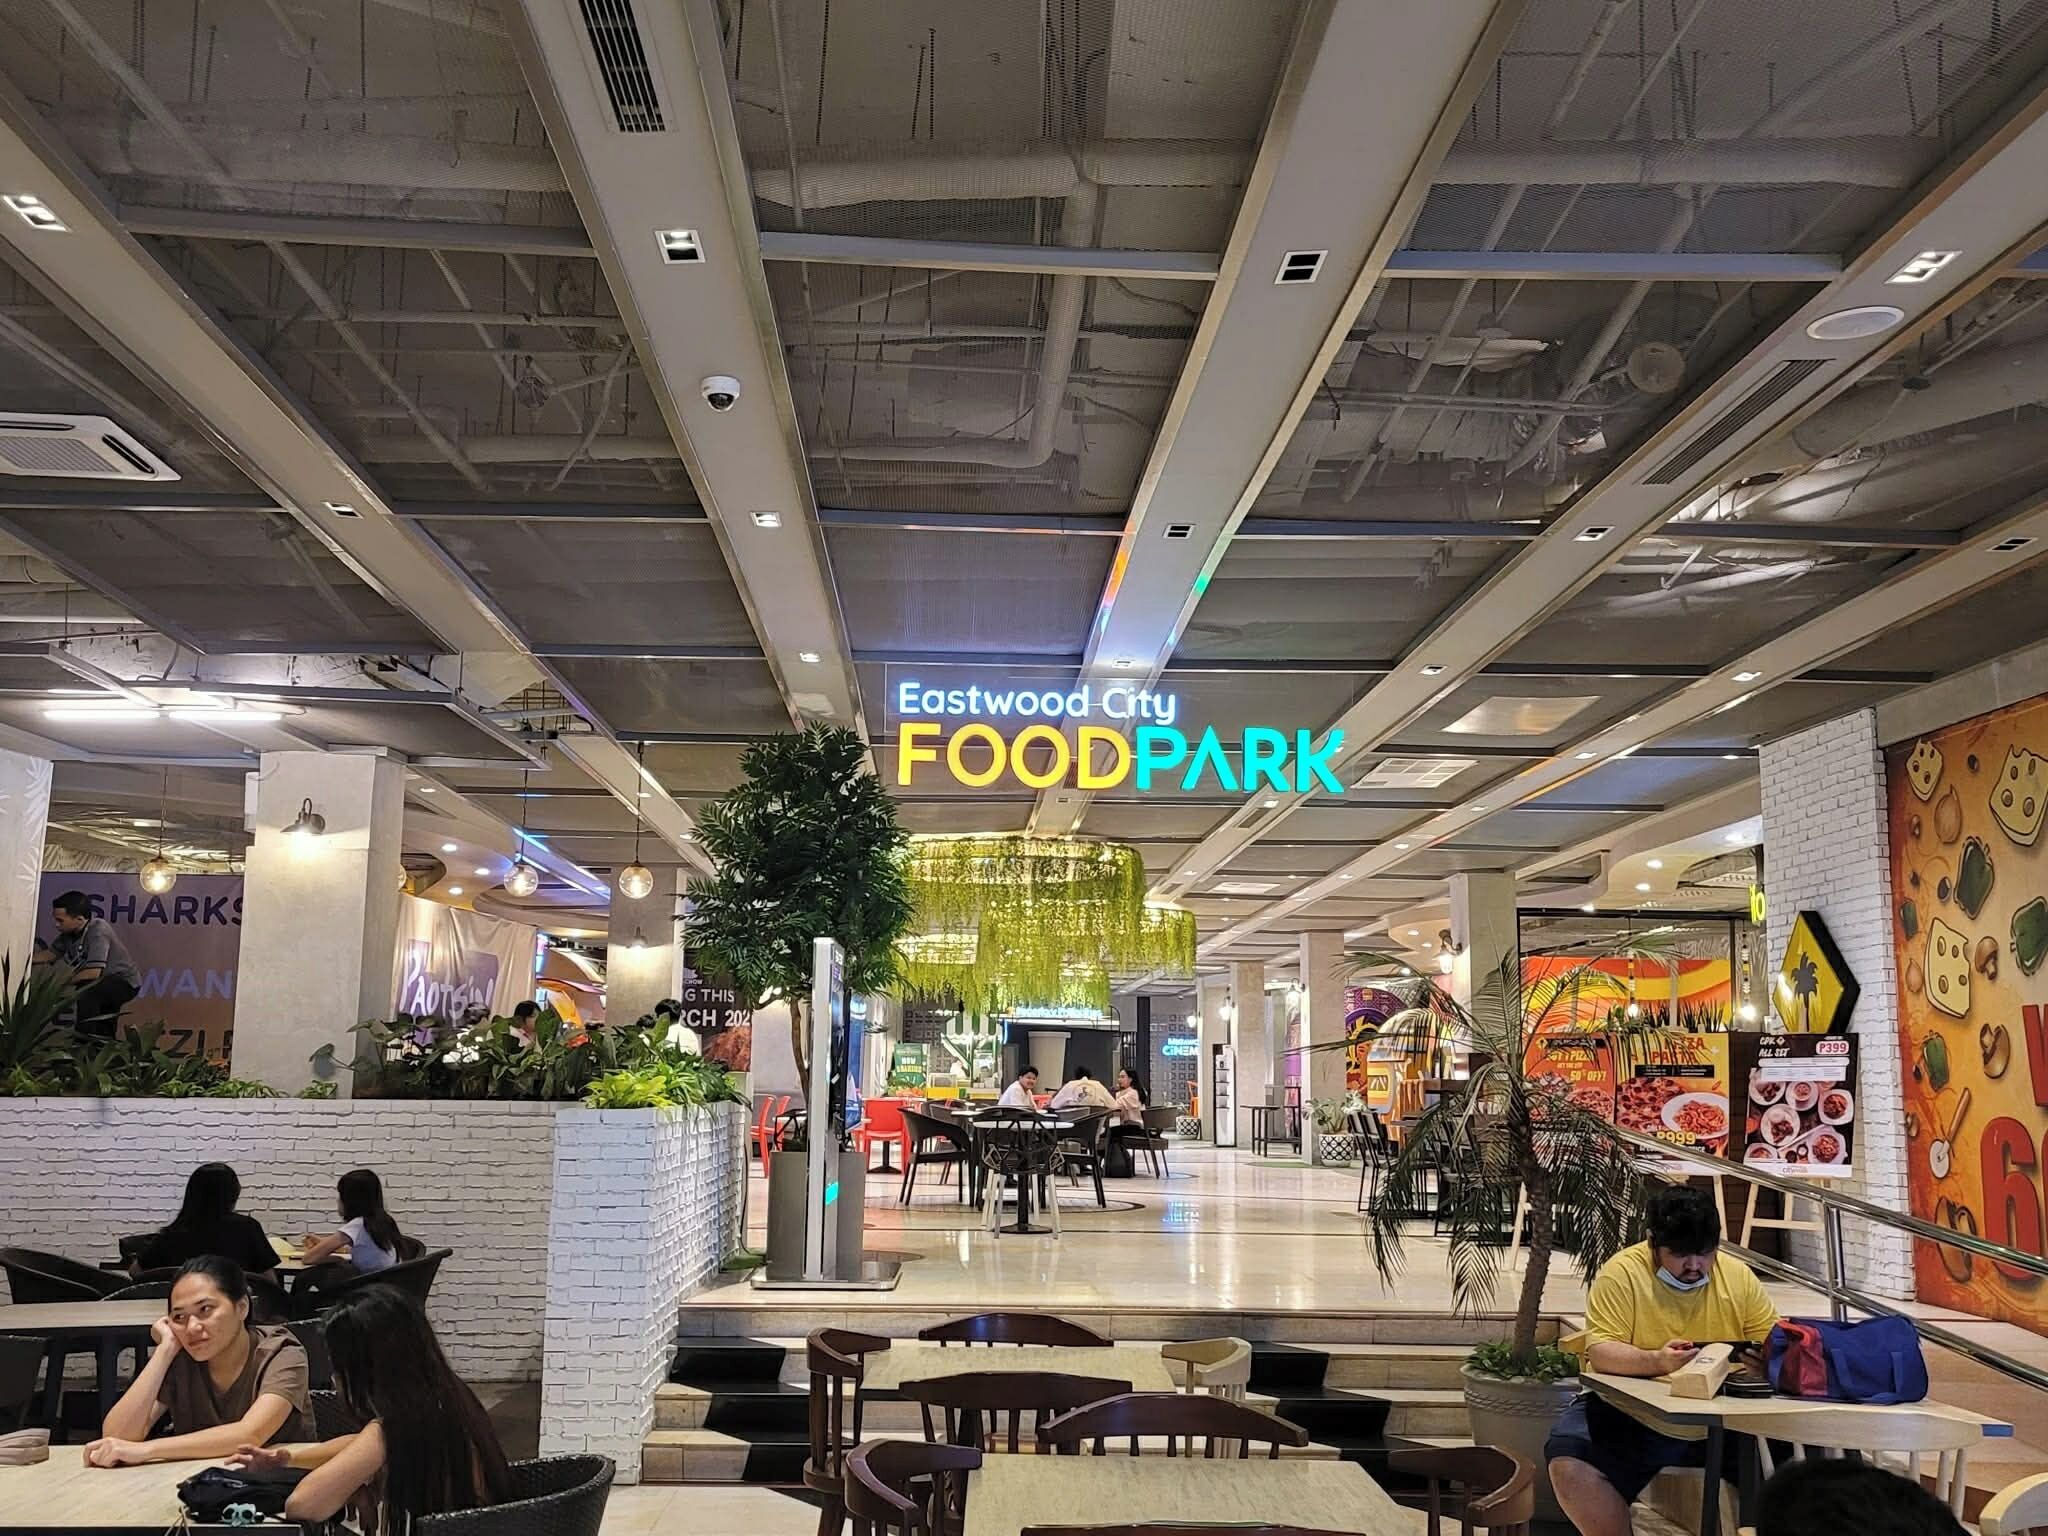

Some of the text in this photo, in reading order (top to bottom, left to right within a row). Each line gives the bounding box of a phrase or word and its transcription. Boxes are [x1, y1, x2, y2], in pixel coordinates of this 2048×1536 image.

[899, 682, 1176, 725] Eastwood City
[898, 722, 1344, 793] FOODPARK
[701, 989, 735, 1002] THIS
[1819, 1042, 1847, 1053] P399
